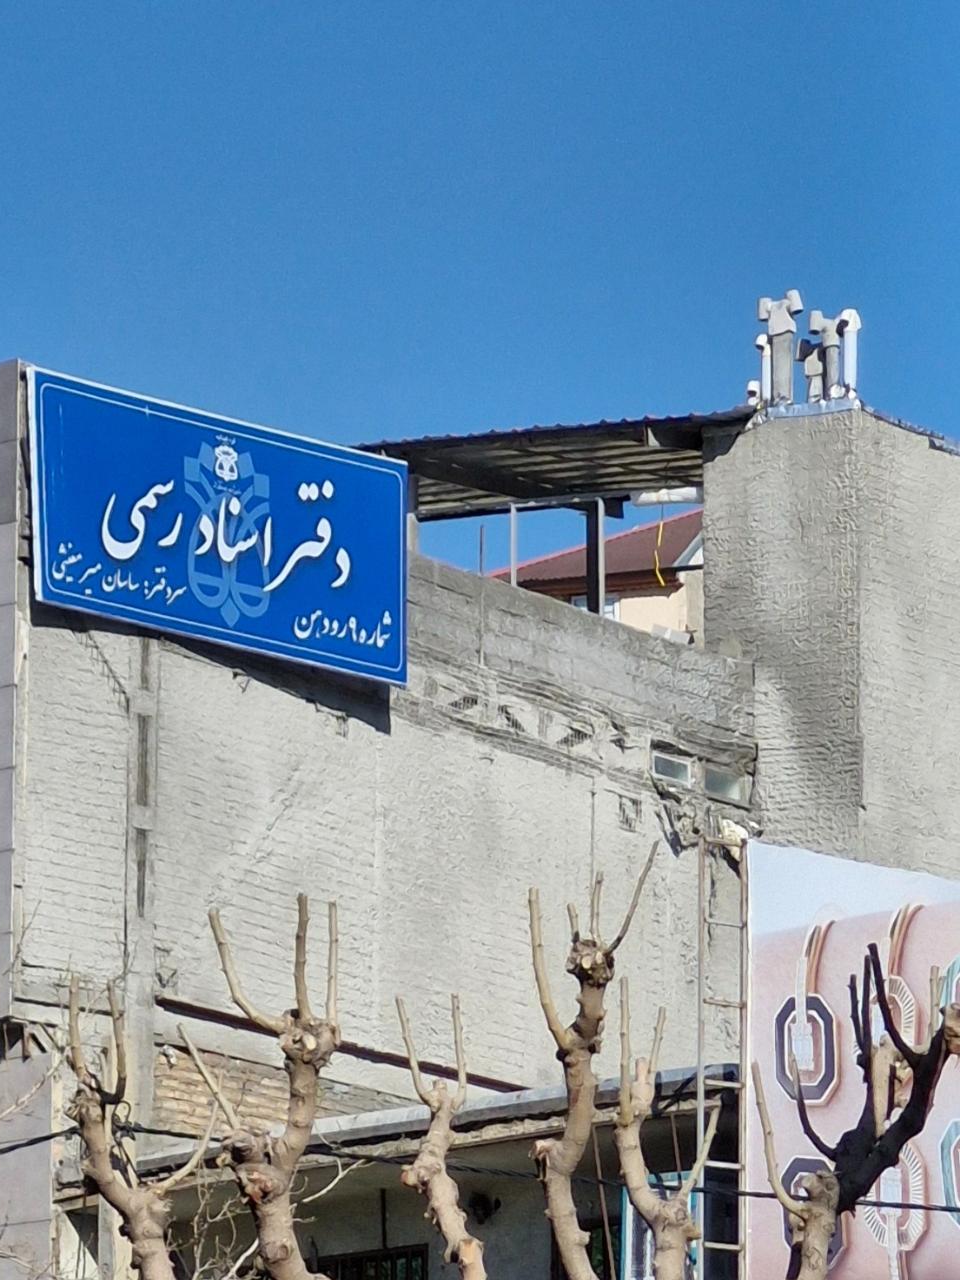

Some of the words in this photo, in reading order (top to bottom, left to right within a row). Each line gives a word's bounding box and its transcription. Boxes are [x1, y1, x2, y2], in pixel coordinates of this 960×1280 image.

[101, 478, 183, 560] رسمی
[195, 496, 272, 567] اسناد
[263, 480, 351, 591] دفتر
[101, 568, 139, 592] ساسان
[293, 609, 347, 639] رودهن
[358, 610, 392, 648] شماره
